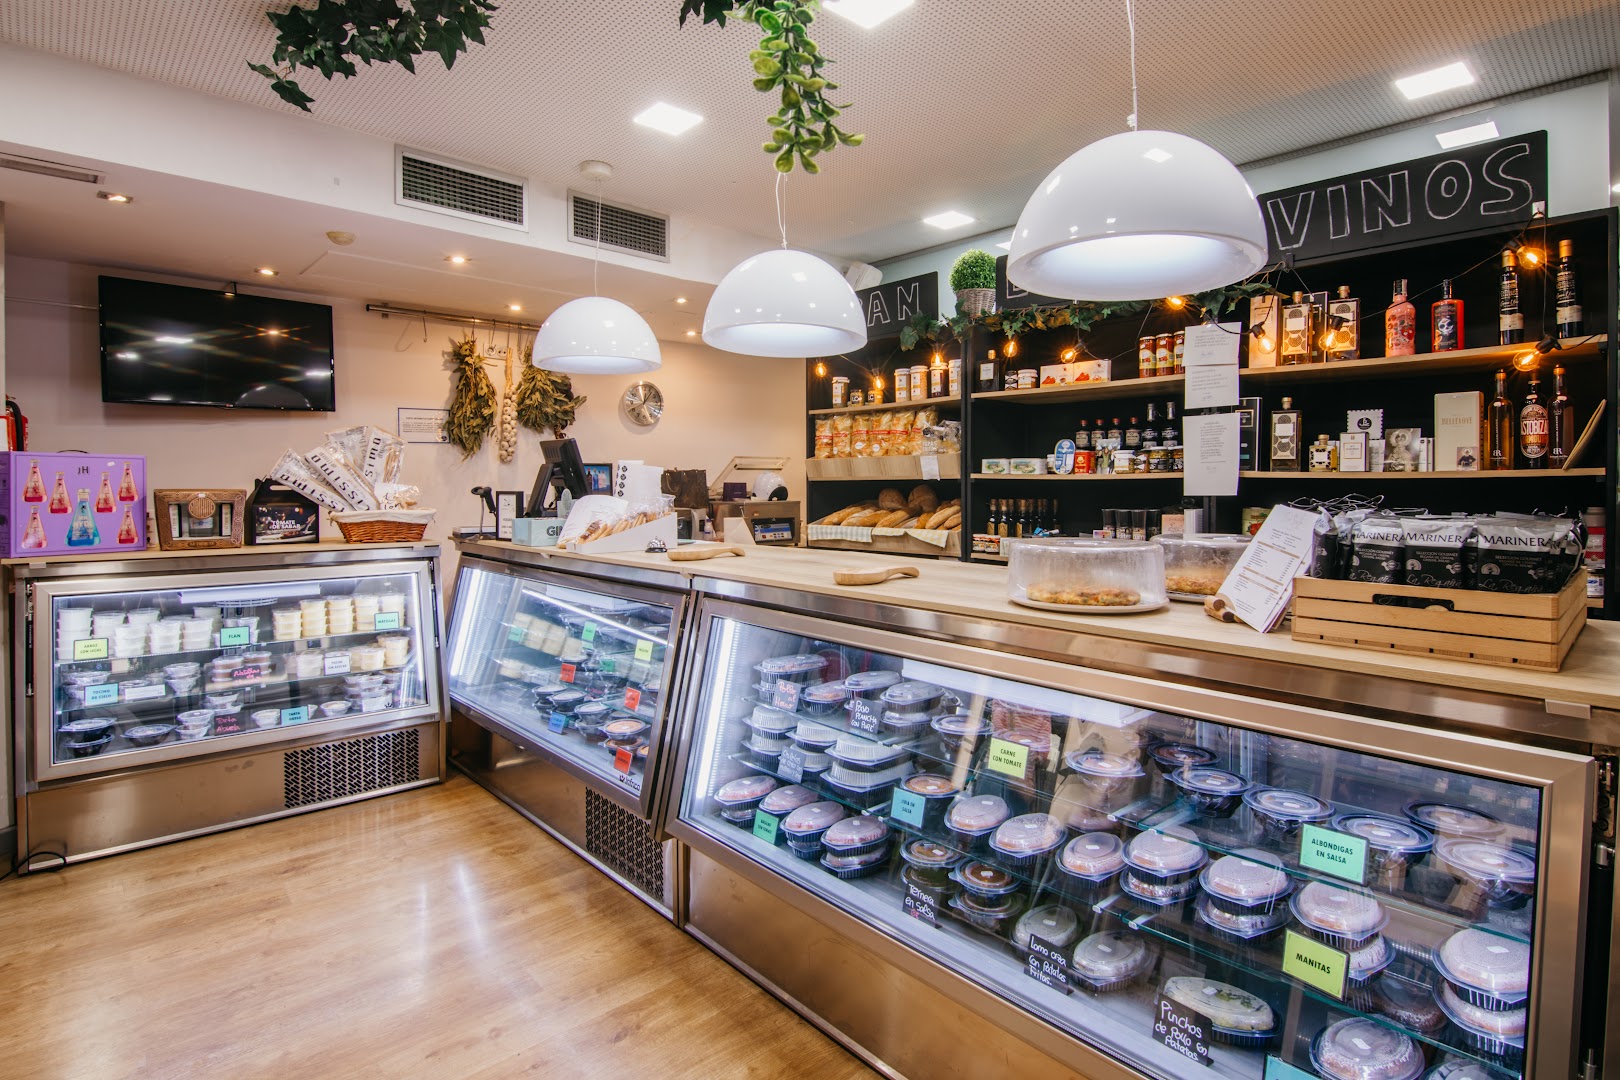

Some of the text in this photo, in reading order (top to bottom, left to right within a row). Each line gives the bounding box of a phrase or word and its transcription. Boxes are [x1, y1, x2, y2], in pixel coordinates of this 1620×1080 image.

[1266, 143, 1533, 250] VINOS
[859, 282, 919, 327] AN
[1000, 748, 1016, 757] CARNE
[1003, 758, 1022, 768] TOMATE
[1311, 838, 1353, 855] ALBONDIGAS
[1316, 849, 1347, 865] EN SALSA
[1295, 952, 1331, 975] MANITAS
[1155, 1020, 1167, 1034] de
[1161, 1000, 1203, 1039] Pinchos
